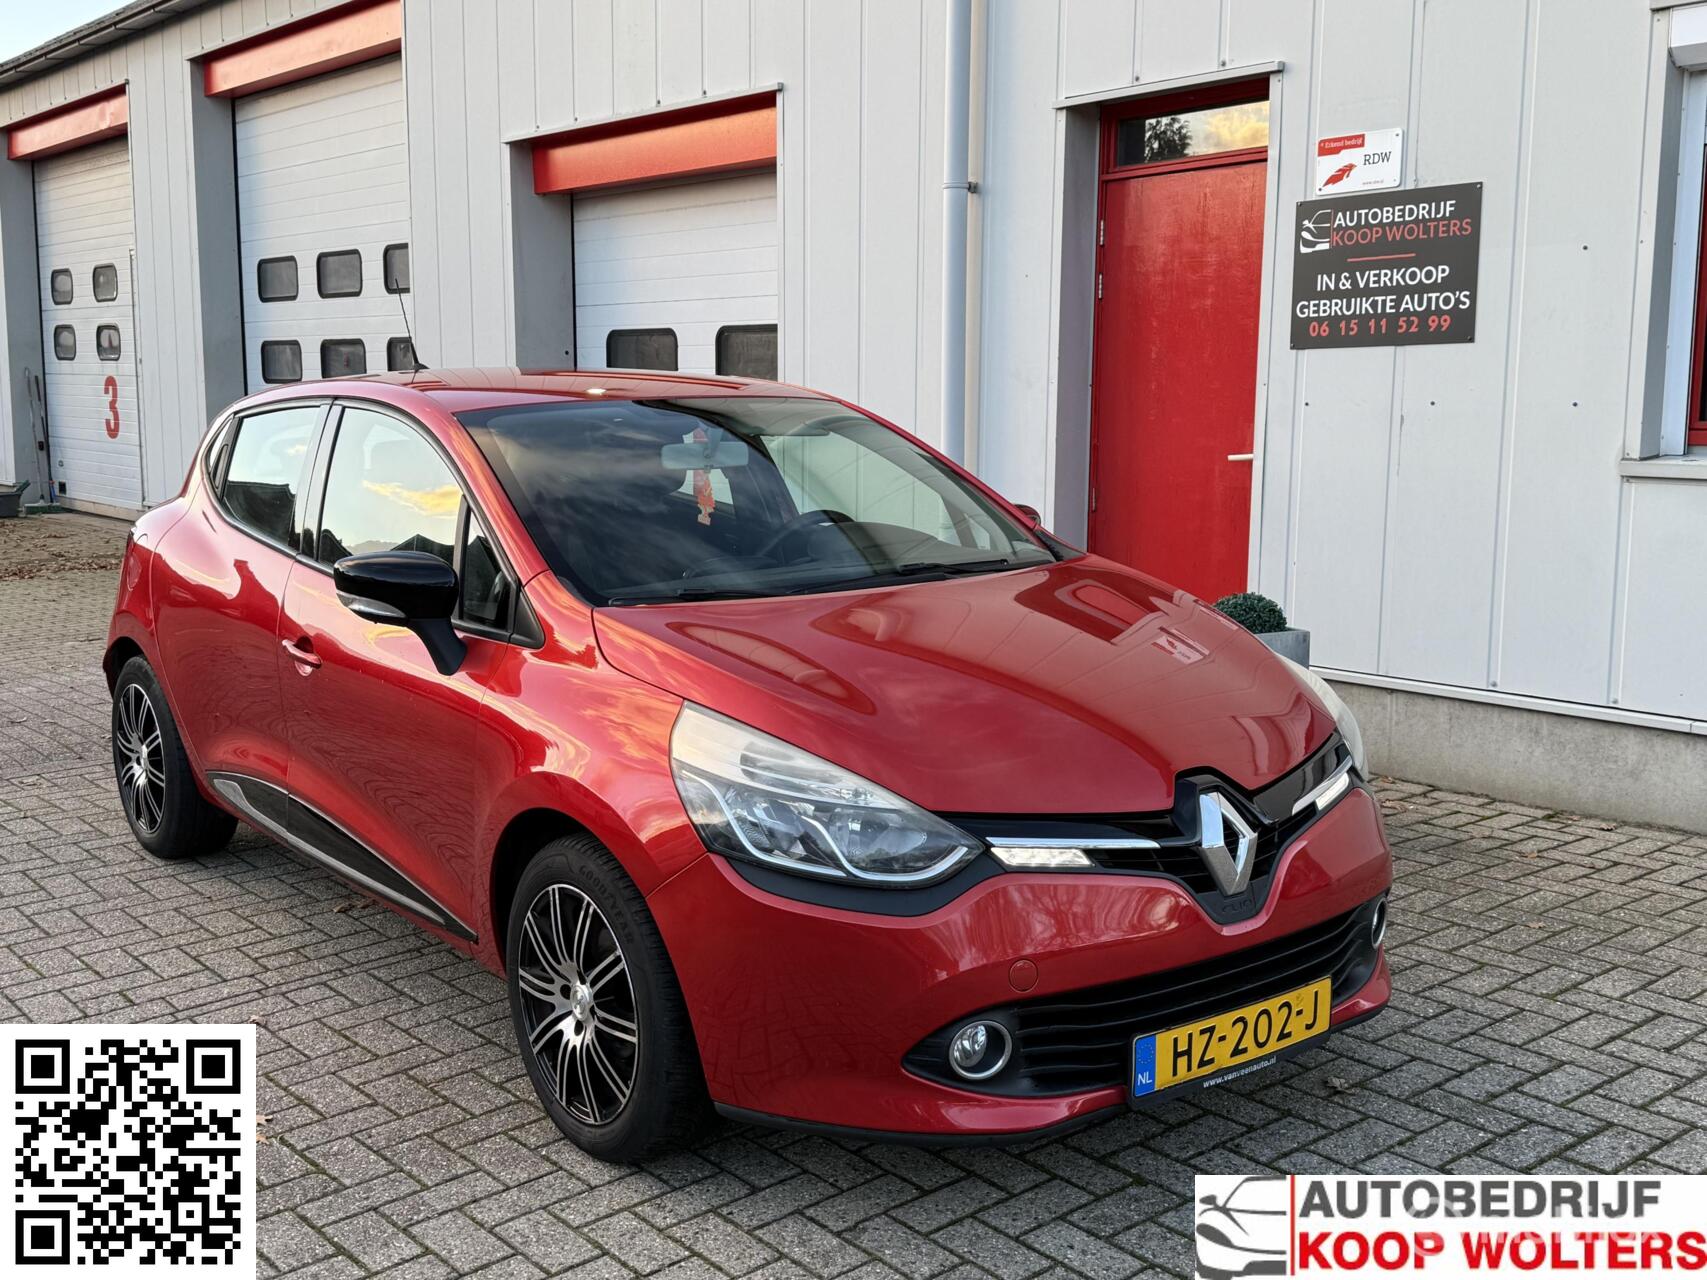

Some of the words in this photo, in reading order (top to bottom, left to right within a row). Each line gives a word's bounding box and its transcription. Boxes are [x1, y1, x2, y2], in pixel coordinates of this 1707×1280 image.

[1345, 137, 1363, 147] bedrijf
[1363, 151, 1392, 166] RDW
[1333, 200, 1456, 228] AUTOBEDRIJF
[1332, 228, 1383, 247] KOOP
[1385, 218, 1472, 241] WOLTERS
[1317, 273, 1336, 291] IN
[1338, 272, 1352, 290] &
[1355, 265, 1450, 289] VERKOOP
[1296, 295, 1397, 318] GEBRUIKTE
[1309, 321, 1330, 337] 06
[1339, 319, 1359, 336] 15
[1368, 318, 1387, 335] 11
[1397, 316, 1420, 333] 52
[1427, 314, 1451, 332] 99
[104, 375, 120, 439] 3
[579, 865, 634, 945] GOODYEAR
[1172, 990, 1319, 1077] HZ-202-J
[1137, 1071, 1153, 1085] NL
[1203, 1055, 1277, 1088] www.vanveenauto.nl
